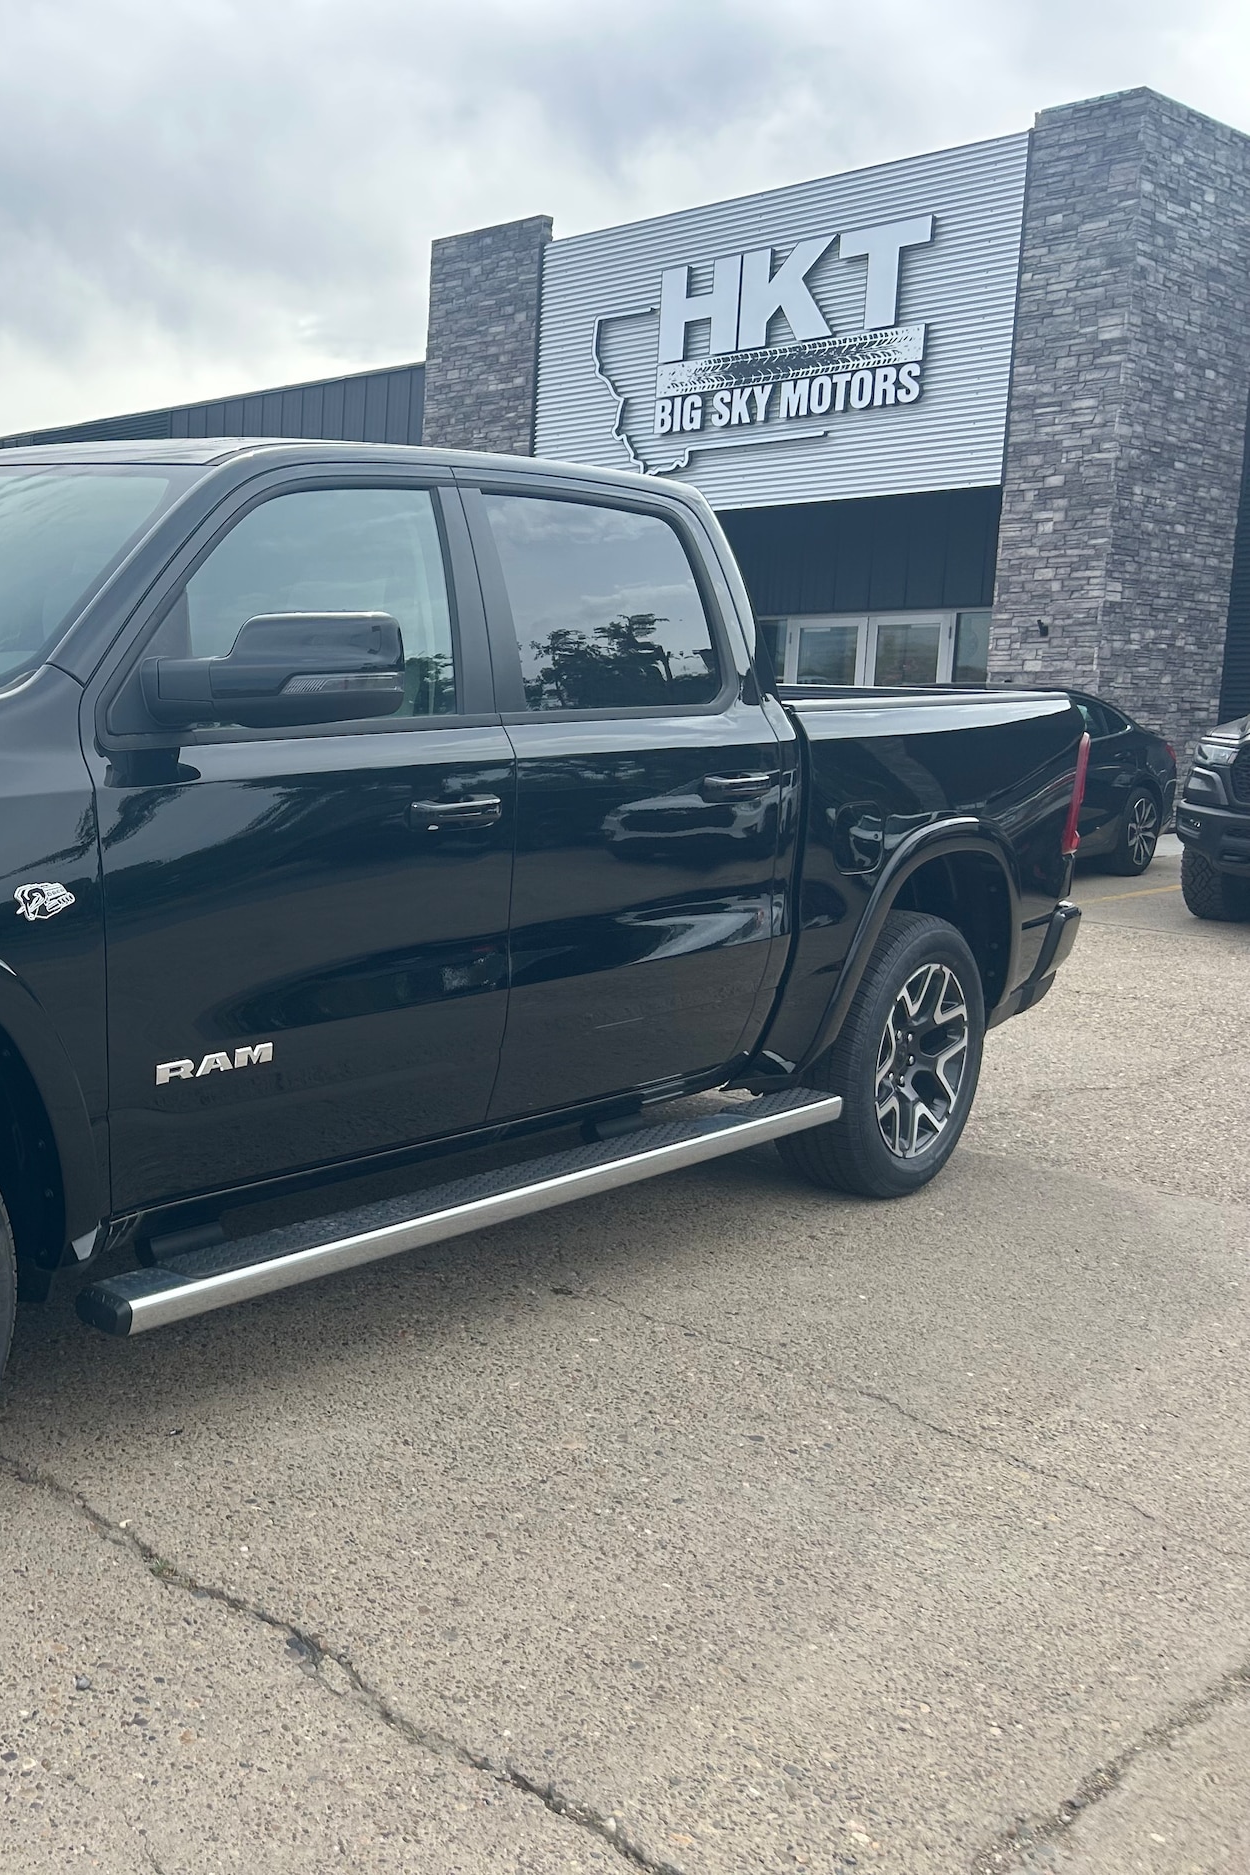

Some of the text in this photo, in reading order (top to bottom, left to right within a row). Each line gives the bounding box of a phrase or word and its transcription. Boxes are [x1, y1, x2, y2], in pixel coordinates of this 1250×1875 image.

[657, 214, 935, 364] HKT
[653, 362, 921, 434] BIG SKY MOTORS
[155, 1042, 273, 1086] RAM
